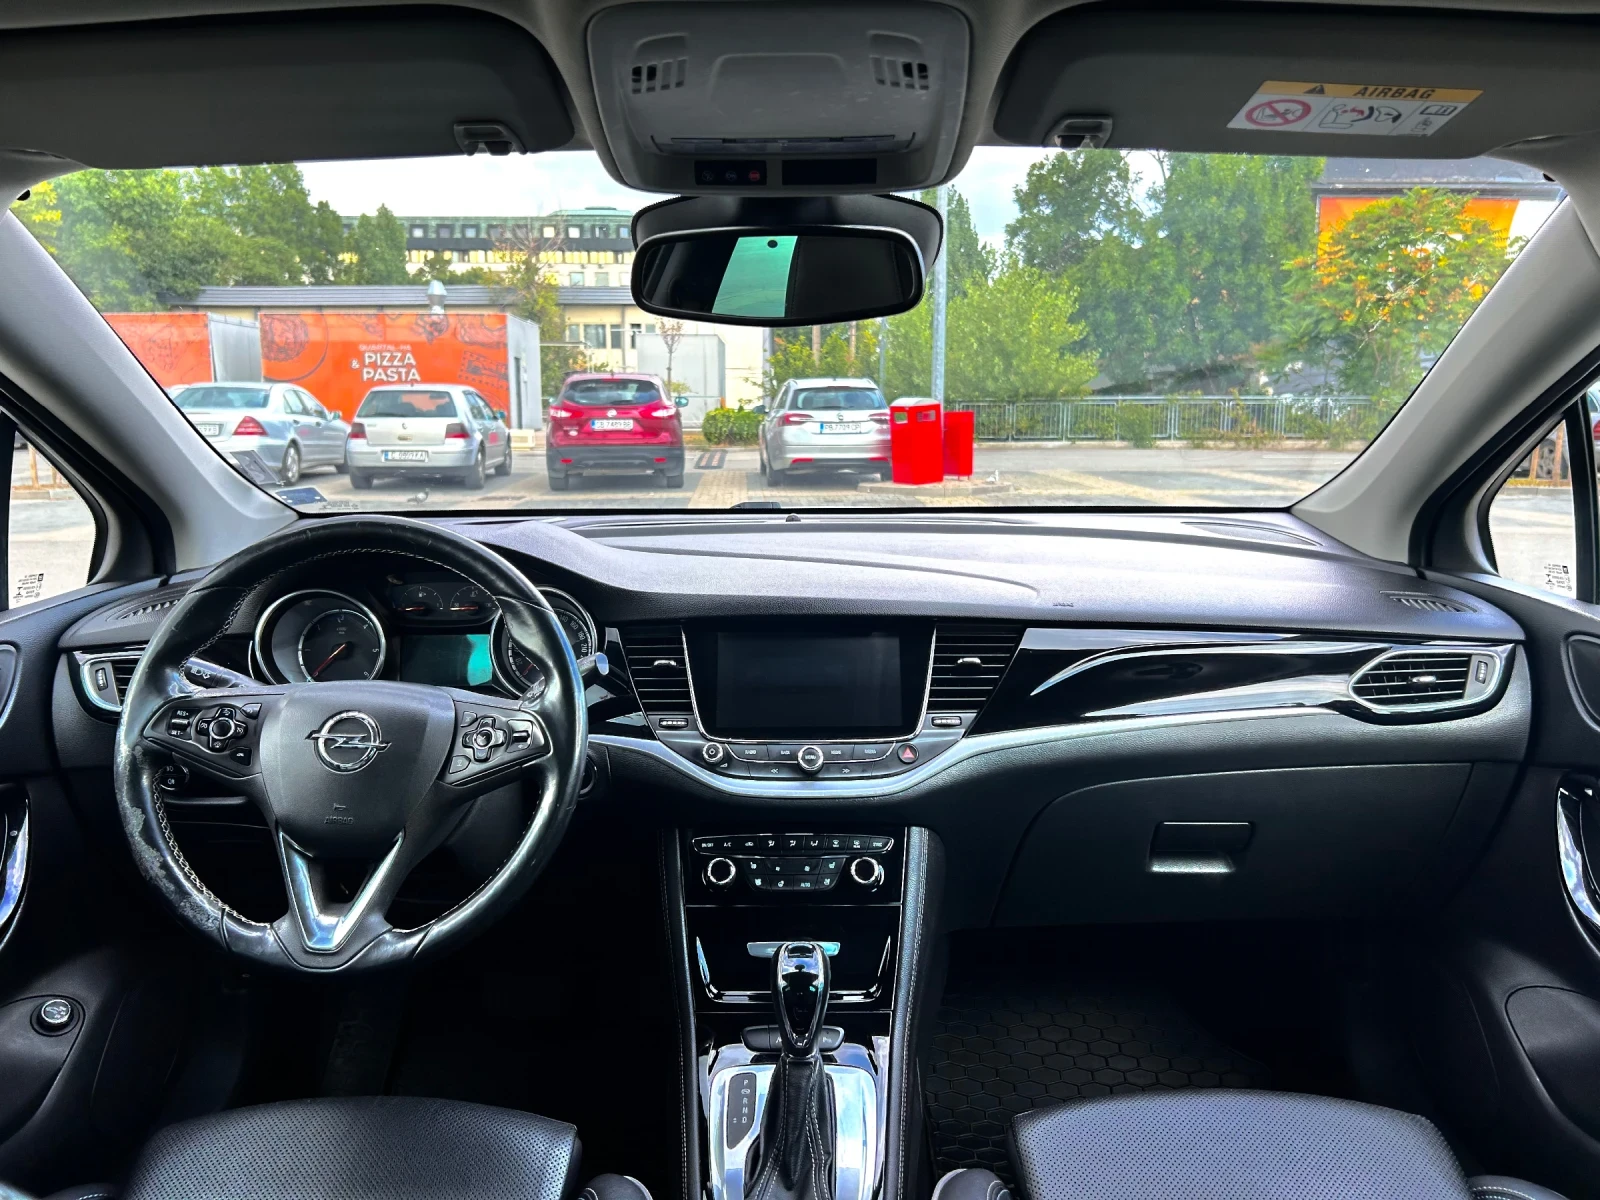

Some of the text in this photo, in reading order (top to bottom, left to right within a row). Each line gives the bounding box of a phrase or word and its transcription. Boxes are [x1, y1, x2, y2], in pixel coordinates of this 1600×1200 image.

[1352, 86, 1436, 100] AIRBAG
[351, 359, 360, 369] &
[364, 352, 416, 366] PIZZA
[363, 367, 421, 382] PASTA
[577, 631, 586, 640] 180
